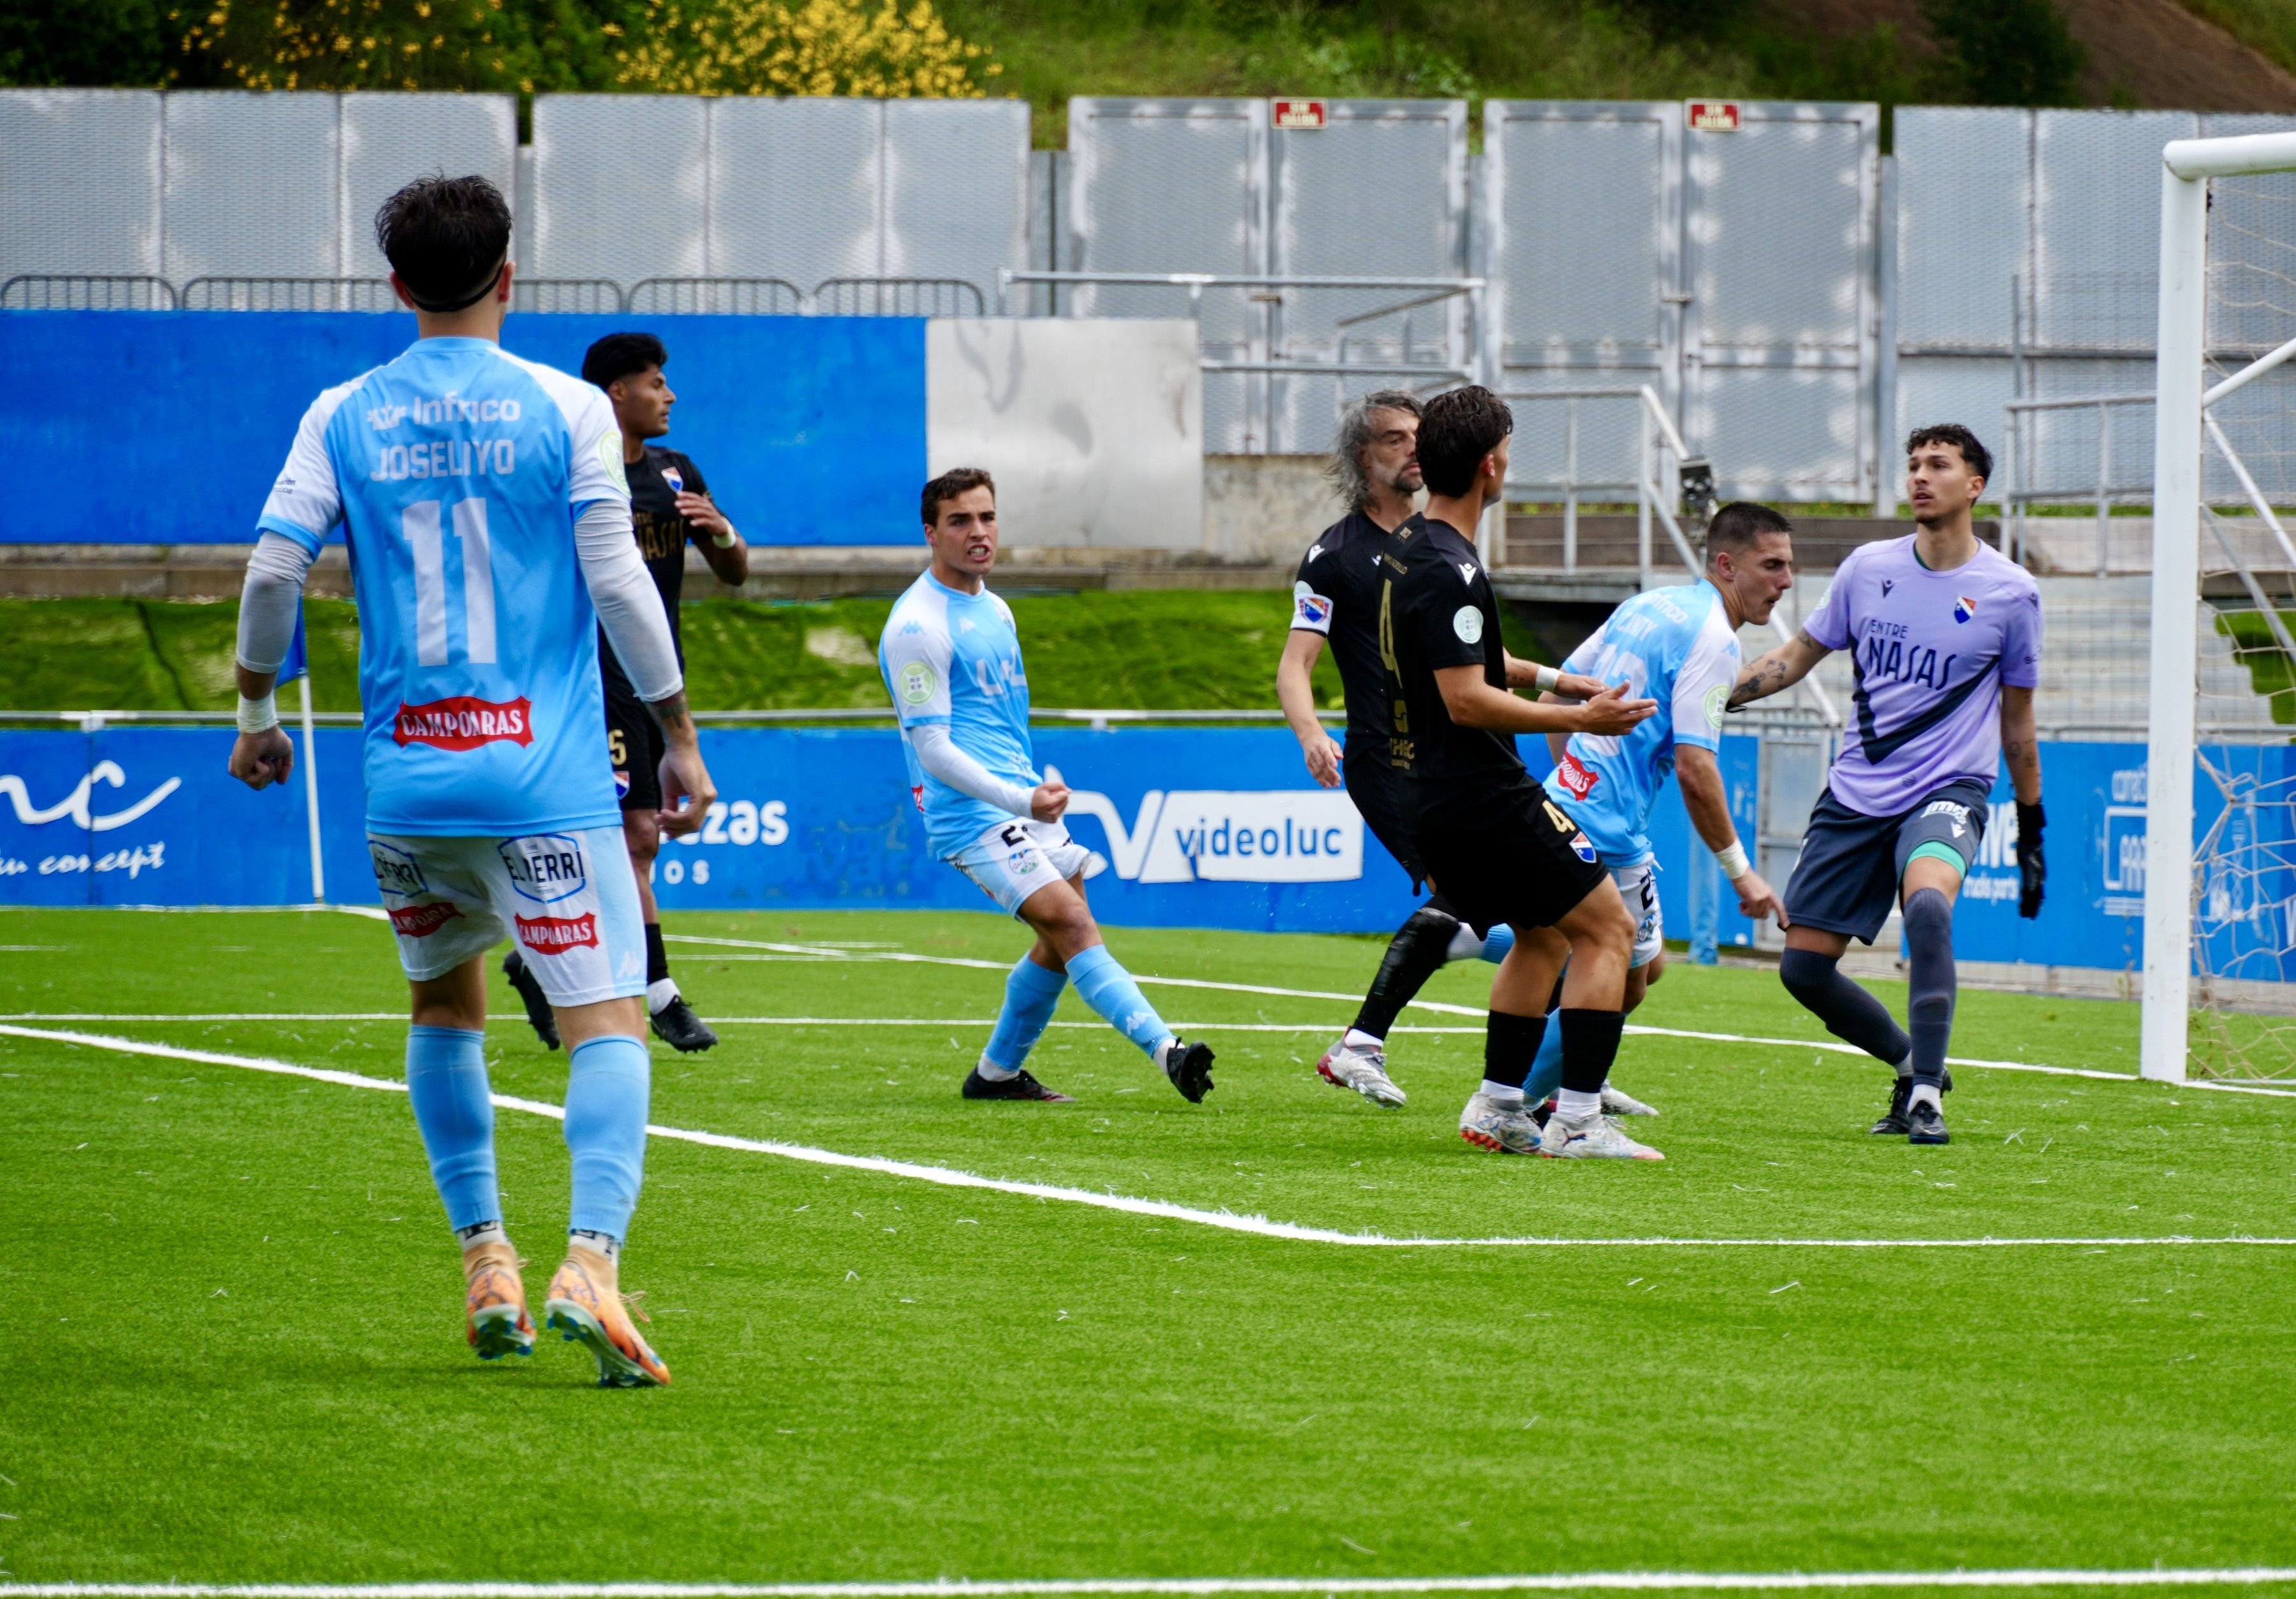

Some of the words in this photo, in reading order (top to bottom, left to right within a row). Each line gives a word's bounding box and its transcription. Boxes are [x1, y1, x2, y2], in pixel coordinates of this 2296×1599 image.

[413, 391, 521, 425] Infrico
[401, 497, 497, 667] 11
[1379, 578, 1404, 689] 4
[1870, 619, 1909, 639] ENTRE
[1869, 636, 1957, 691] NASAS
[401, 709, 524, 737] CAMPOARAS
[608, 728, 627, 765] 5
[1541, 799, 1577, 833] 4
[1175, 818, 1343, 857] videoluc
